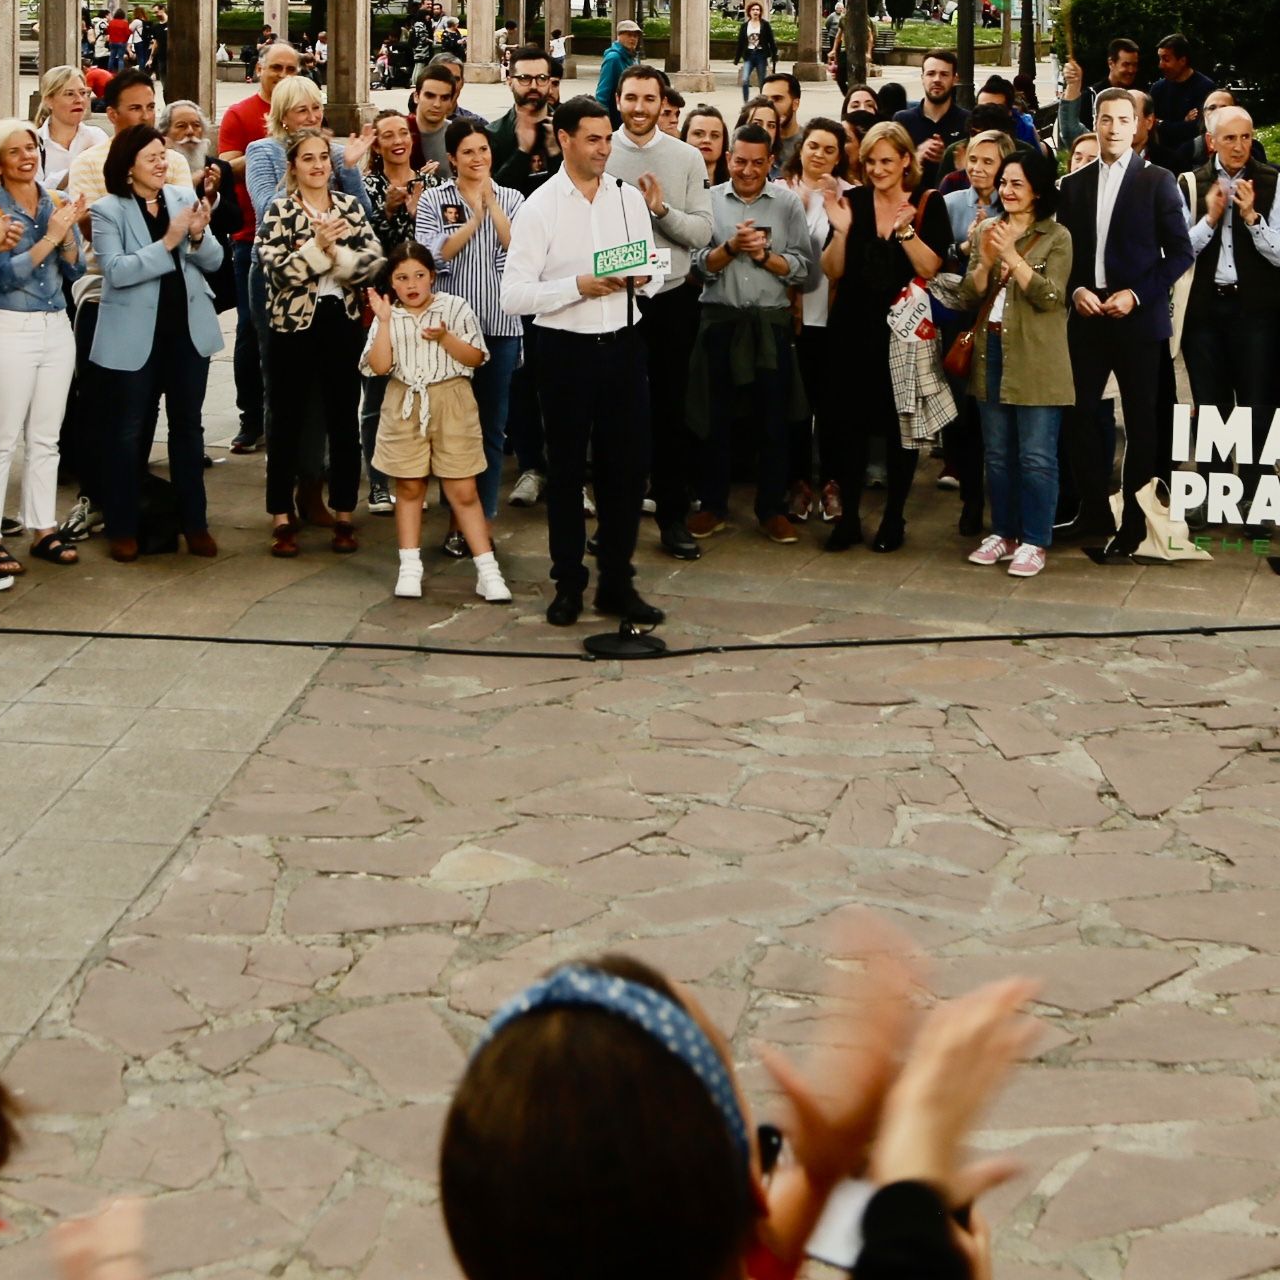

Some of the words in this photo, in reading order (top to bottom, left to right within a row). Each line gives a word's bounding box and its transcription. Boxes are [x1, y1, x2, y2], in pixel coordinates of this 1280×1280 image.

[597, 249, 645, 269] EUSKADI
[598, 242, 644, 259] AUKERATU
[896, 302, 927, 338] berria
